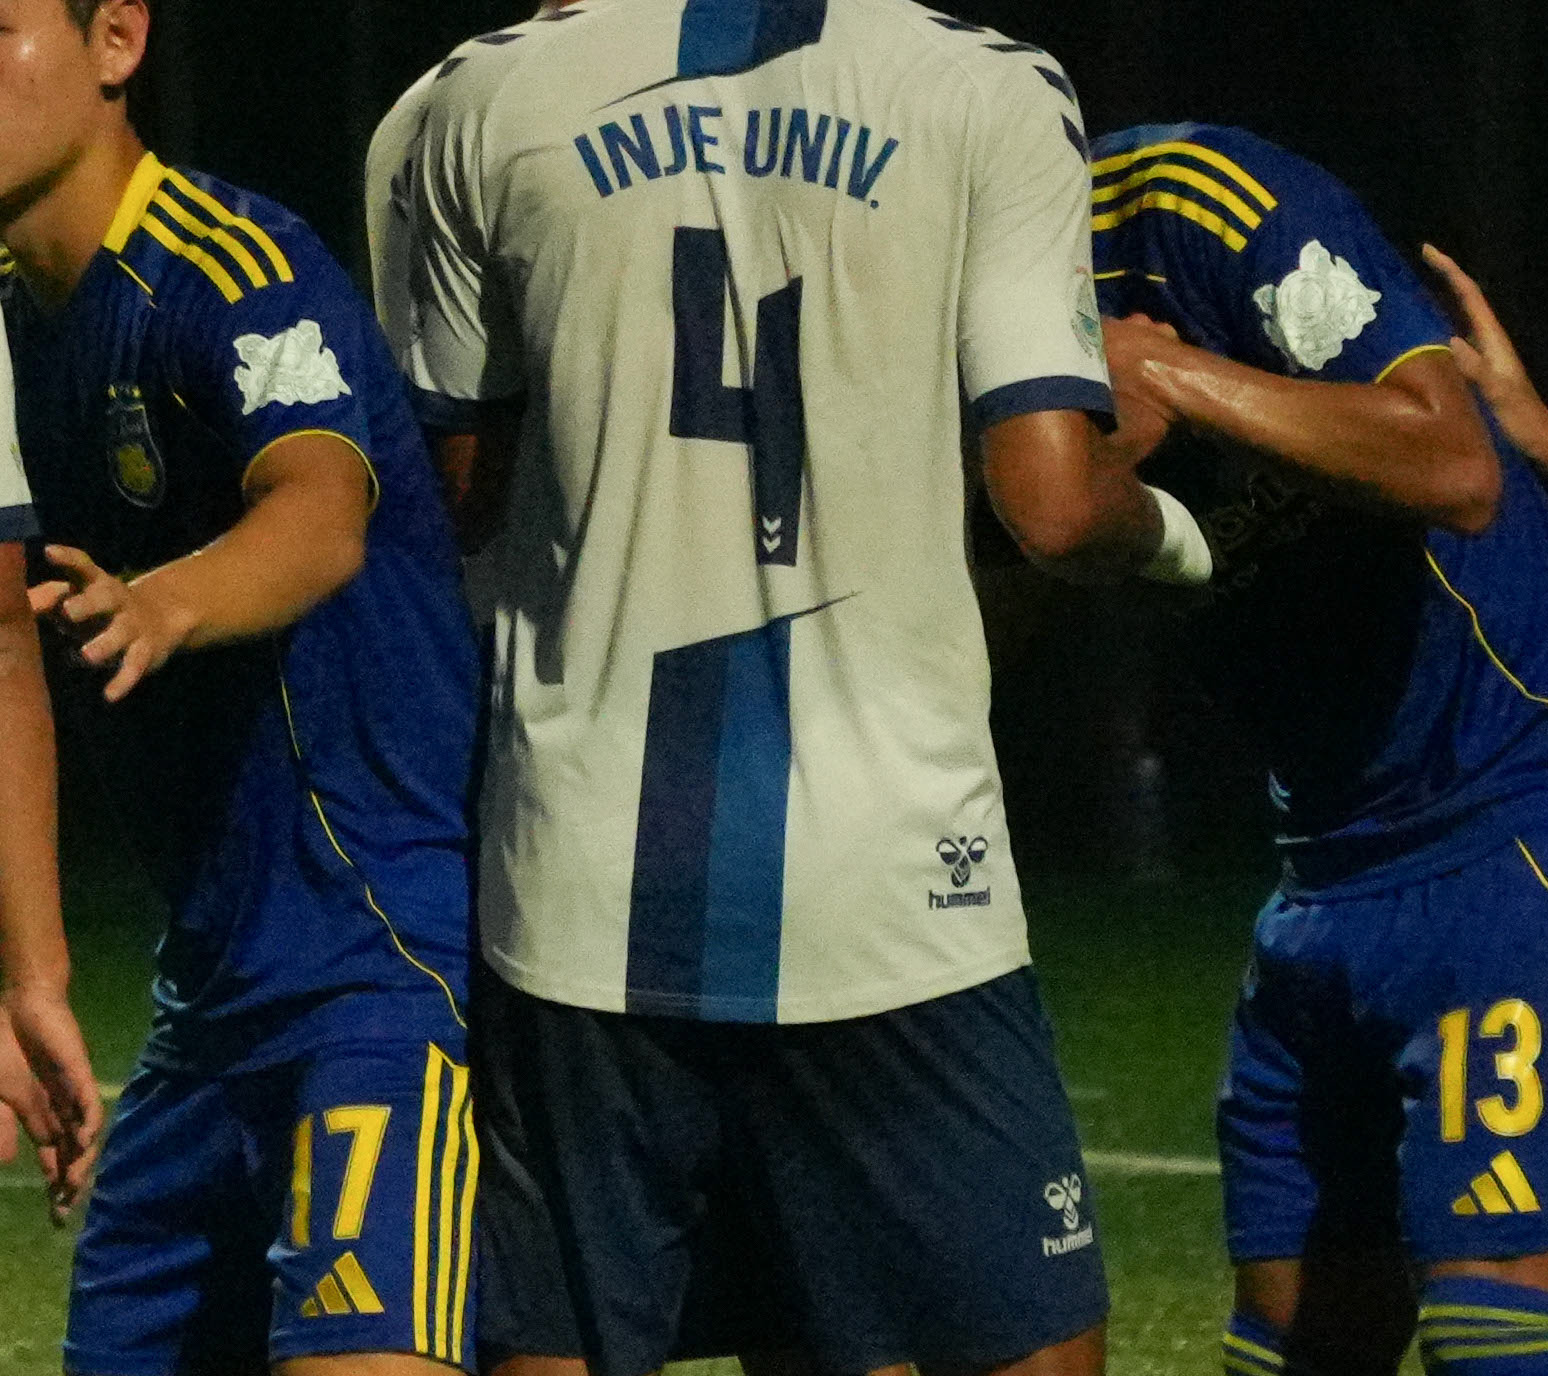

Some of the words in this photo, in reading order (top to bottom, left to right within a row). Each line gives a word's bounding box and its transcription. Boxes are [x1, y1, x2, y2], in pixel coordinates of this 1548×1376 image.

[573, 104, 724, 199] INJE
[743, 106, 900, 210] UNIV.
[670, 226, 803, 566] 4
[928, 886, 991, 910] hummel
[1436, 997, 1545, 1142] 13
[290, 1104, 392, 1248] 17
